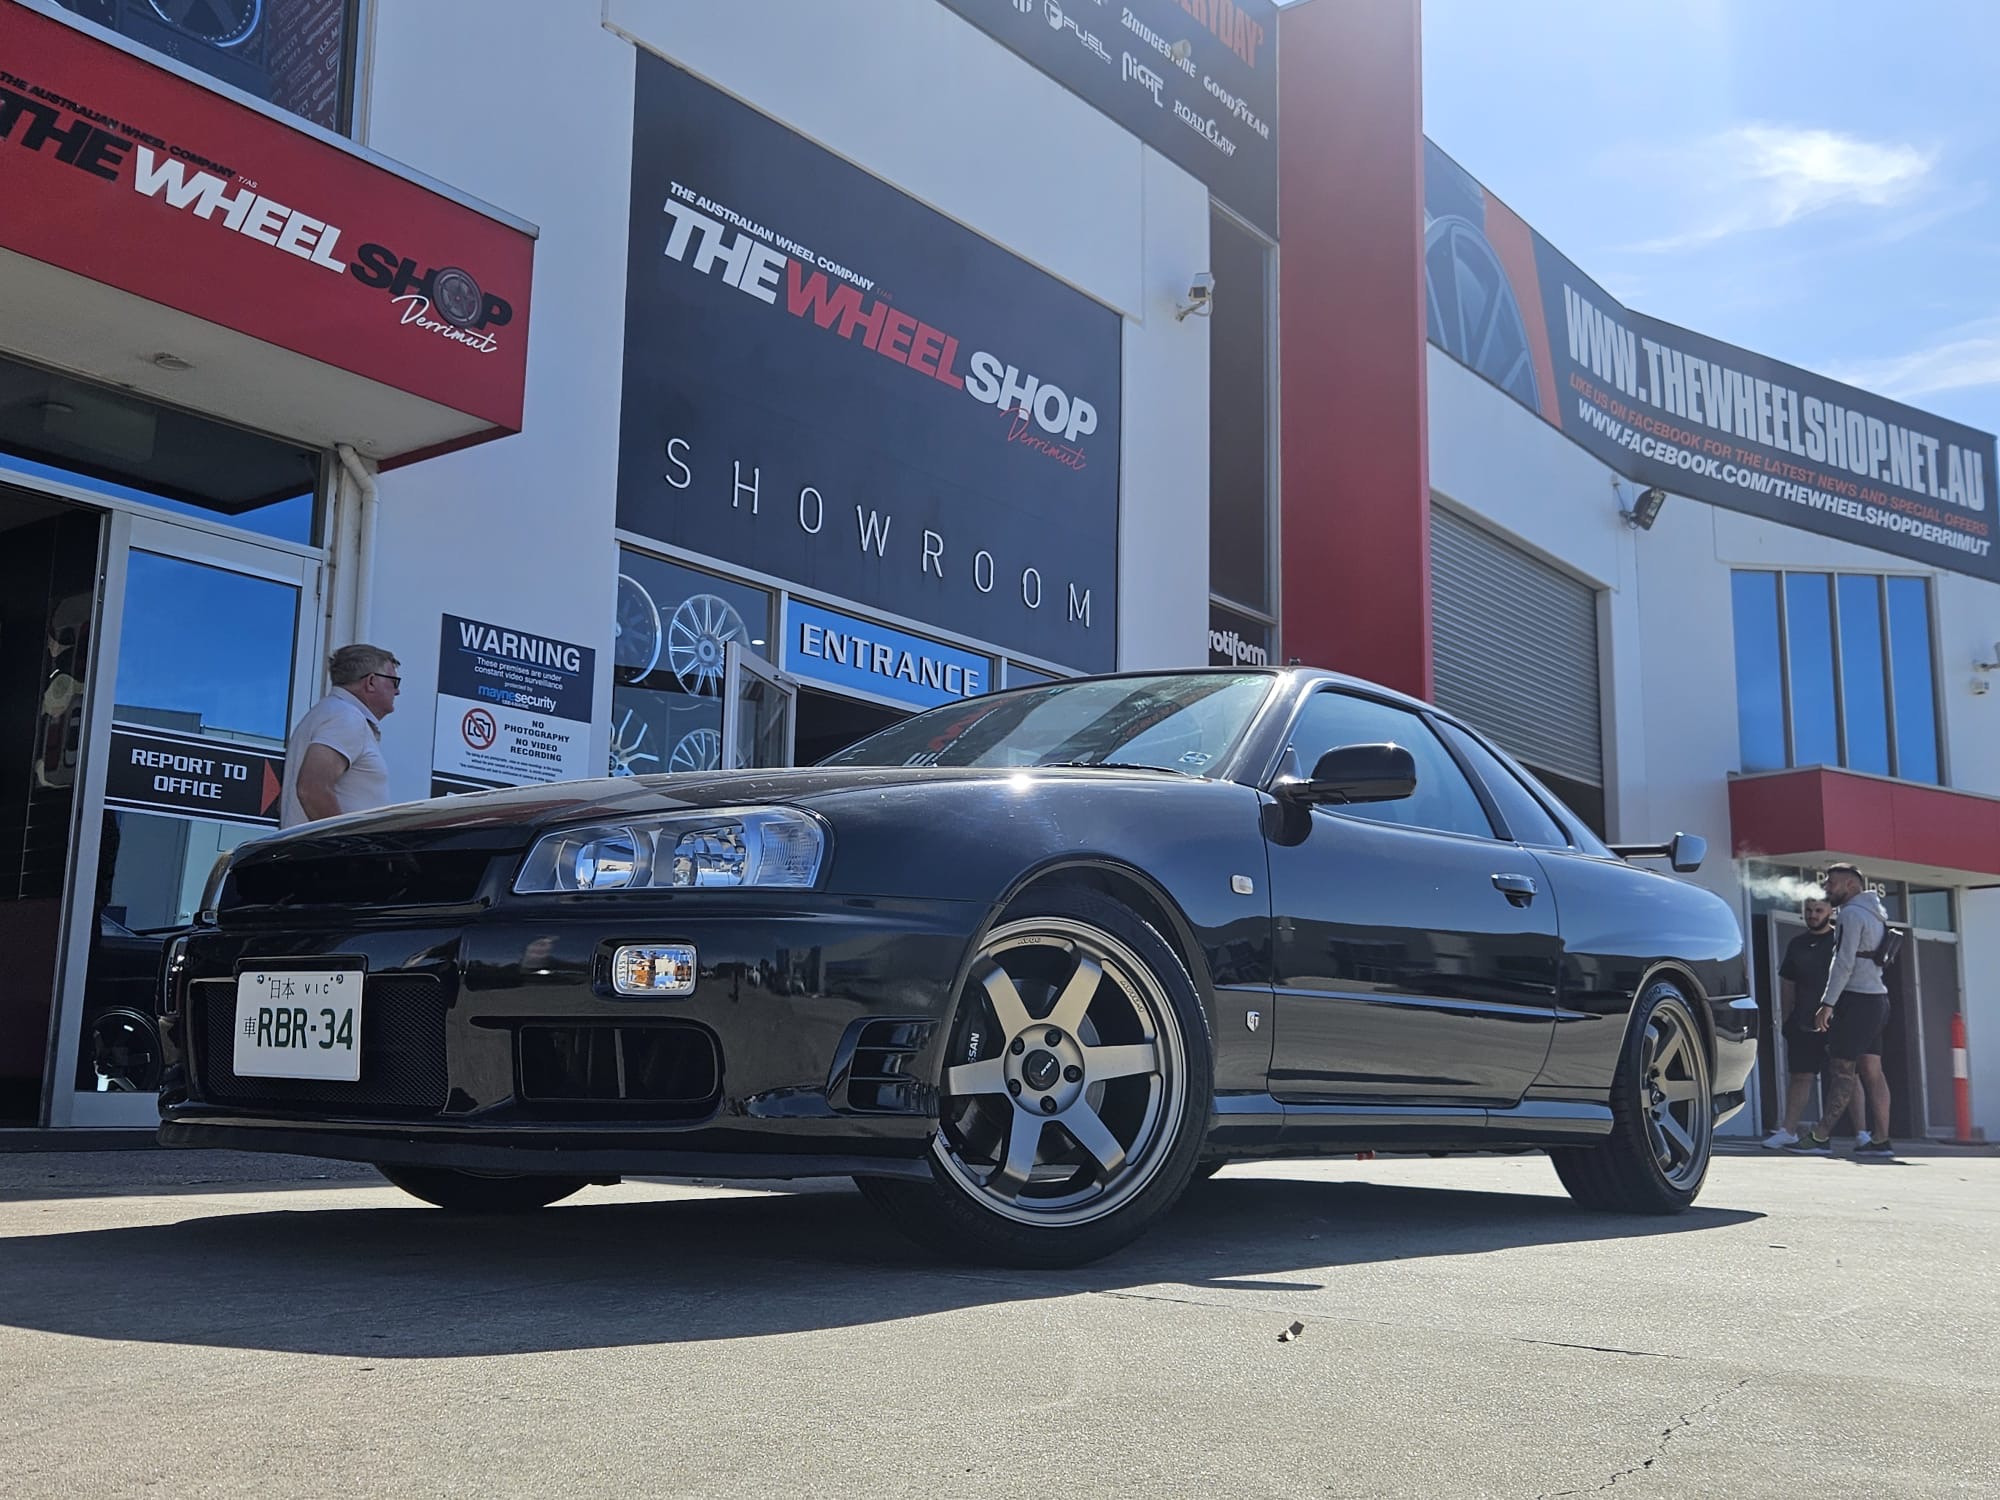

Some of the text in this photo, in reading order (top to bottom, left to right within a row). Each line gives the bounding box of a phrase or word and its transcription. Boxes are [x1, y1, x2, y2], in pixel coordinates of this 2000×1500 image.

[1121, 7, 1196, 78] BRIDGESNE
[0, 71, 258, 188] THE AUSTRALIAN WHEEL COMPANY T/AS
[1203, 75, 1269, 140] GOODYEAR
[0, 87, 133, 181] THE
[134, 144, 346, 274] WHEEL
[670, 181, 874, 291] THE AUSTRALIAN WHEEL COMPANY
[391, 295, 497, 353] Derrimut
[663, 198, 1098, 442] THE WHEEL SHOP
[1564, 283, 1985, 512] WWW.THEWHEELSHOP.NET.AU
[1000, 407, 1087, 471] Derrimut
[1569, 372, 1989, 537] LIKE US ON FACEBOOK FOR THE LATEST NEWS AND SPECIAL OFFERS
[1578, 398, 1991, 556] WWW.FACEBOOK.COM/THEWHEELSHOPDERRIMUT
[665, 438, 1091, 627] SHOWROOM
[459, 621, 581, 672] WARNING
[477, 657, 562, 681] These premises are under
[801, 623, 979, 698] ENTRANCE
[1208, 629, 1267, 667] rotiform
[474, 666, 563, 690] constant video surveillance
[504, 723, 570, 743] PHOTOGRAPHY
[516, 737, 558, 752] NO VIDEO
[532, 720, 544, 729] NO
[131, 748, 247, 781] REPORT TO
[510, 745, 562, 761] RECORDING
[153, 775, 222, 799] OFFICE
[270, 978, 295, 1000] 日本
[304, 983, 329, 994] VIC
[243, 1016, 256, 1038] 車
[257, 1007, 353, 1051] RBR-34
[967, 1032, 980, 1064] SSAN
